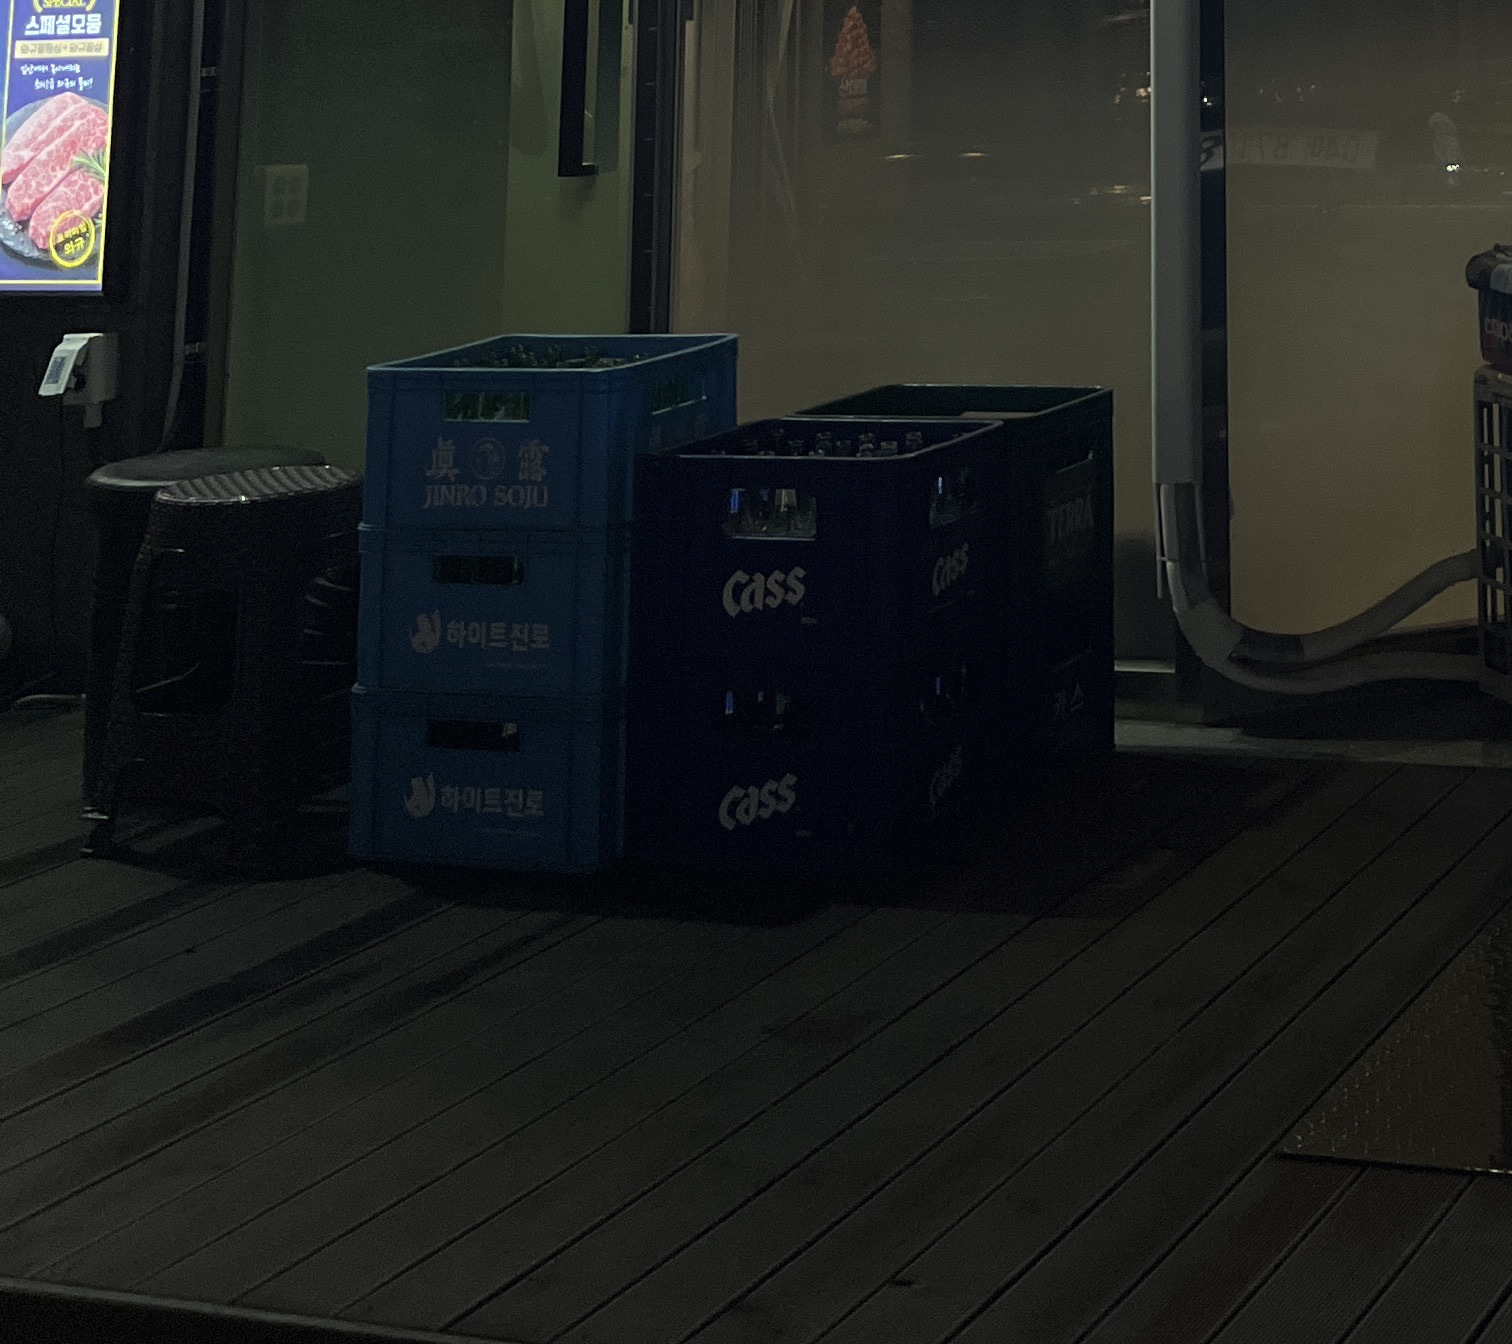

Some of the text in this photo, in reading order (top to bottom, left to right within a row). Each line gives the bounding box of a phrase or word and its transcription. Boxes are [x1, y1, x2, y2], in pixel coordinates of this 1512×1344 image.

[422, 483, 549, 509] JINRO SOJU
[446, 619, 551, 653] 하이트진로
[439, 782, 546, 819] 하이트진로
